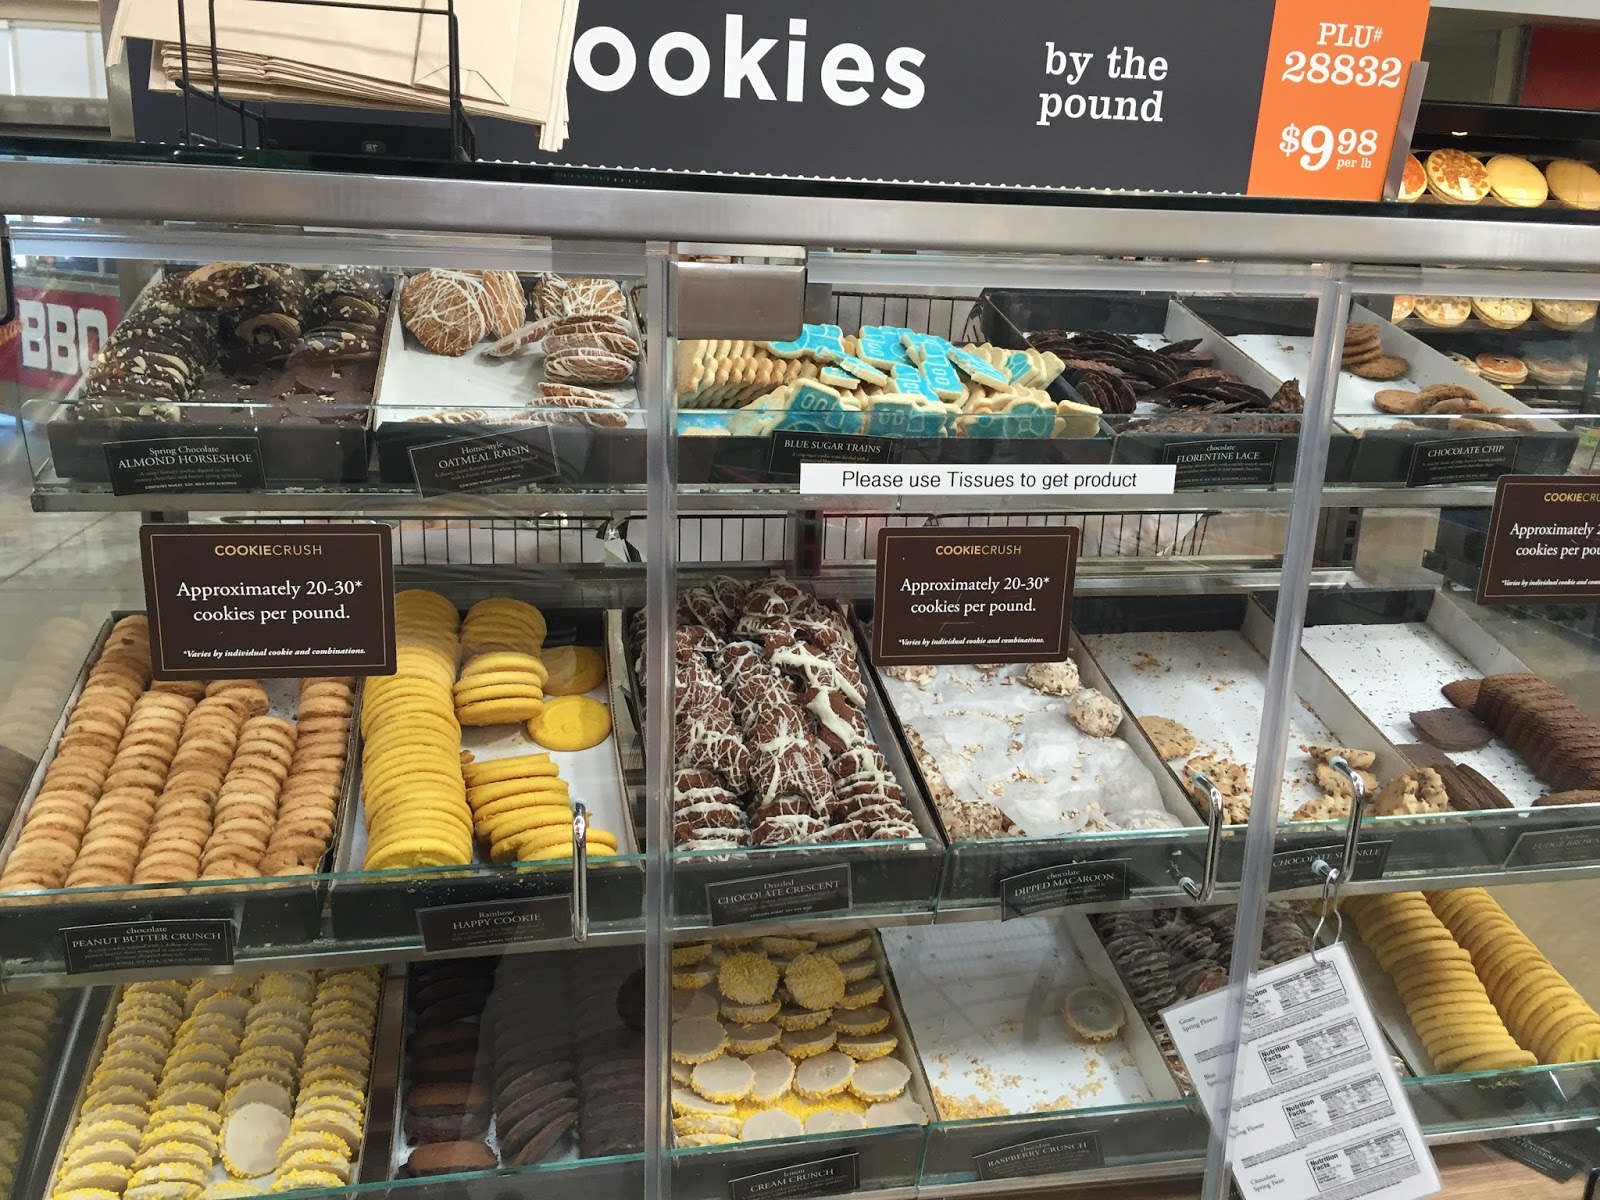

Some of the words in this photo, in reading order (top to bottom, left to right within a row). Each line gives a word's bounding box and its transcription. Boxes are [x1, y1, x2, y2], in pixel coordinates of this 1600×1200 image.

[1316, 23, 1384, 48] PLU#
[1044, 42, 1093, 85] by
[1107, 46, 1169, 81] the
[1281, 51, 1403, 88] 28832
[1036, 91, 1165, 126] pound
[1336, 157, 1357, 170] per
[1360, 157, 1372, 169] lb
[149, 447, 177, 457] Spring
[178, 445, 219, 454] Chocolate
[784, 439, 809, 449] BLUE
[811, 441, 844, 451] SUGAR
[845, 443, 881, 453] TRAINS
[1206, 444, 1236, 452] chocolate
[1427, 446, 1480, 458] CHOCOLATE
[1481, 445, 1505, 453] CHIP
[118, 456, 176, 469] ALMOND
[178, 454, 253, 464] HORSESHOE
[438, 453, 492, 469] OATMEAL
[493, 445, 530, 458] RAISIN
[1177, 452, 1234, 463] FLORENTINE
[1236, 452, 1260, 460] LACE
[842, 470, 903, 487] Please
[909, 474, 941, 487] use
[947, 471, 1015, 488] Tissues
[1020, 473, 1036, 488] to
[1041, 473, 1069, 490] get
[1073, 472, 1137, 490] product
[1509, 522, 1595, 539] Approximately
[214, 544, 322, 556] COOKIECRUSH
[935, 545, 1021, 556] COOKIECRUSH
[1516, 543, 1558, 556] cookies
[1560, 546, 1580, 559] per
[176, 580, 301, 601] Approximately
[900, 577, 1000, 596] Approximately
[193, 605, 255, 621] cookies
[260, 609, 287, 624] per
[292, 604, 350, 624] pound.
[911, 599, 960, 613] cookies
[963, 602, 985, 616] per
[989, 598, 1036, 616] pound.
[922, 638, 931, 647] by
[931, 637, 965, 645] individual
[1001, 636, 1045, 644] combinations.
[213, 649, 223, 659] by
[224, 648, 267, 657] individual
[268, 648, 293, 656] cookie
[294, 647, 311, 656] and
[312, 647, 366, 655] combinations.
[1272, 851, 1332, 867] CHOCOLATE
[1046, 870, 1080, 880] chocolate
[717, 888, 784, 905] CHOCOLATE
[785, 880, 840, 894] CRESCENT
[1014, 882, 1051, 897] DIPPED
[1052, 873, 1115, 887] MACAROON
[478, 910, 514, 918] Rainbow
[453, 919, 491, 930] HAPPY
[493, 914, 542, 925] COOKIE
[126, 926, 167, 934] chocolate
[72, 936, 120, 948] PEANUT
[123, 934, 169, 943] BUTTER
[171, 932, 221, 940] CRUNCH
[1261, 1044, 1290, 1057] Nutrition
[1264, 1053, 1282, 1063] Facts
[1286, 1099, 1315, 1113] Nutrition
[1288, 1108, 1307, 1118] Facts
[987, 1149, 1040, 1168] RASPBERRY
[1042, 1142, 1088, 1154] CRUNCH
[1310, 1153, 1339, 1167] Nutrition
[1312, 1162, 1331, 1172] Facts
[750, 1178, 786, 1193] CREAM
[788, 1168, 834, 1183] CRUNCH
